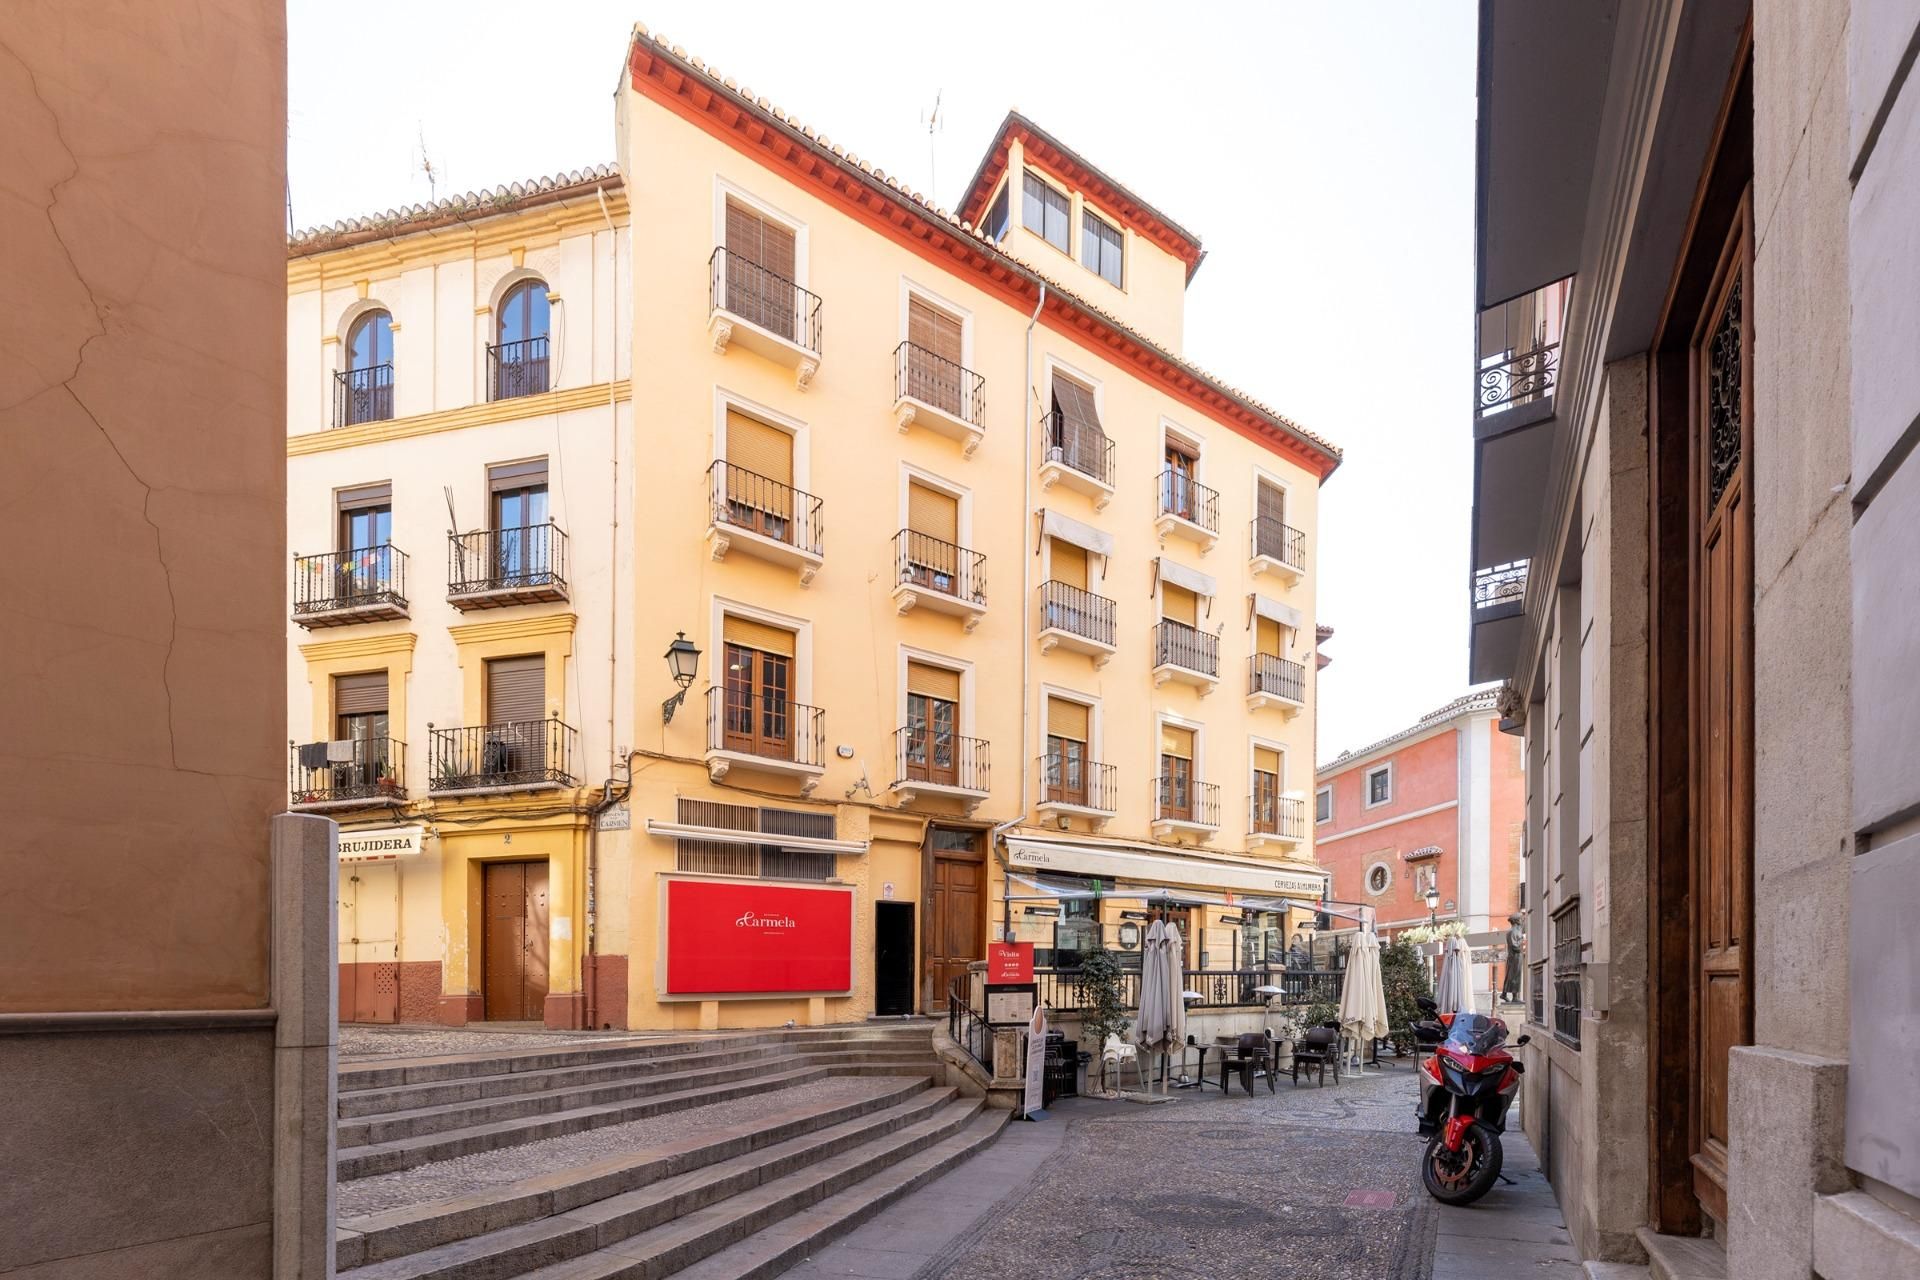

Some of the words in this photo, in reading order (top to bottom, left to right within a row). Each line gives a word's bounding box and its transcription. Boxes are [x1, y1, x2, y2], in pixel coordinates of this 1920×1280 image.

[503, 832, 512, 846] 2
[1014, 848, 1050, 863] Carmela
[1274, 879, 1296, 890] CERVEZAS
[735, 911, 796, 928] Carmela
